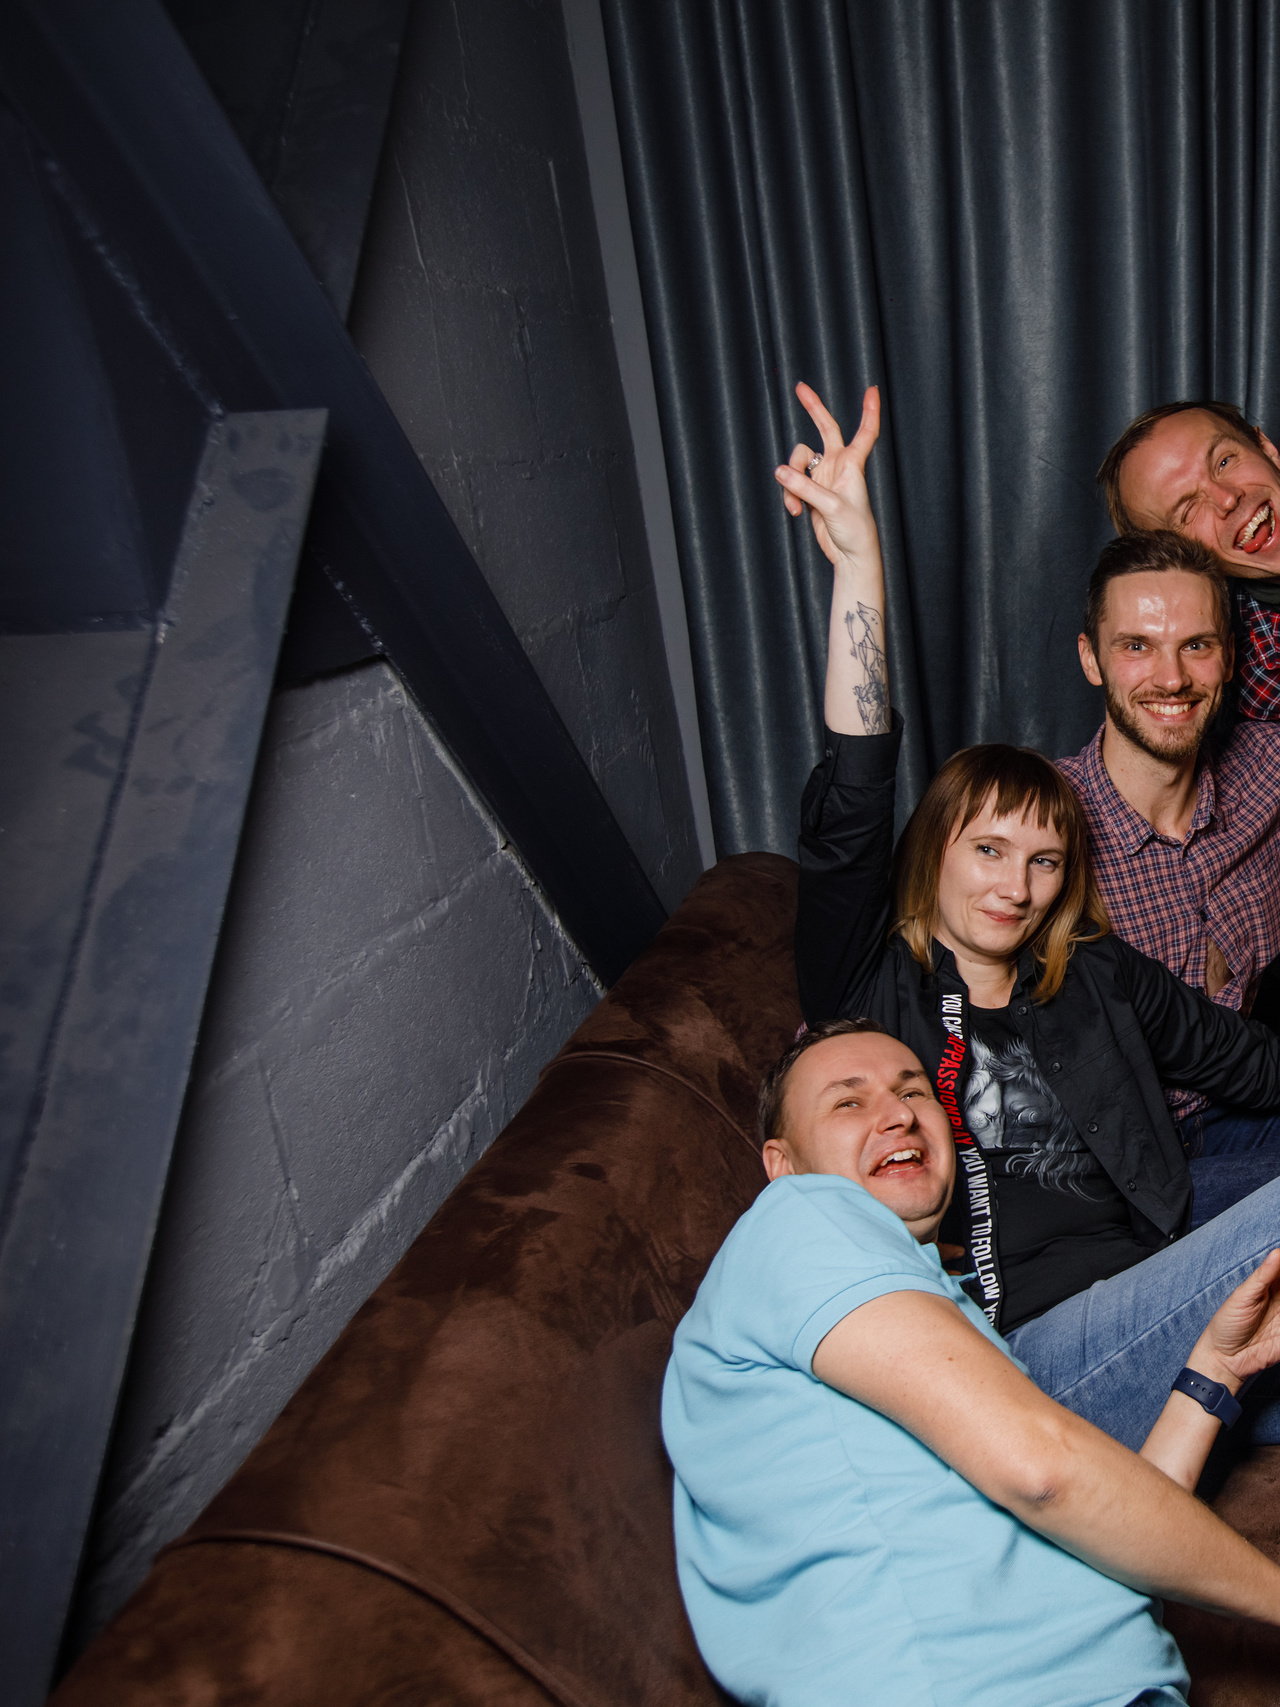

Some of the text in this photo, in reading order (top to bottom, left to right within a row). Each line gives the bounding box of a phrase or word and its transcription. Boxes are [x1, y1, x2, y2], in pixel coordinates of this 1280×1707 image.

[942, 994, 962, 1014] YOU
[959, 1147, 986, 1173] YOU
[968, 1172, 991, 1217] WANT
[971, 1218, 993, 1237] TO
[971, 1236, 1000, 1300] FOLLOW
[983, 1301, 999, 1327] YO
